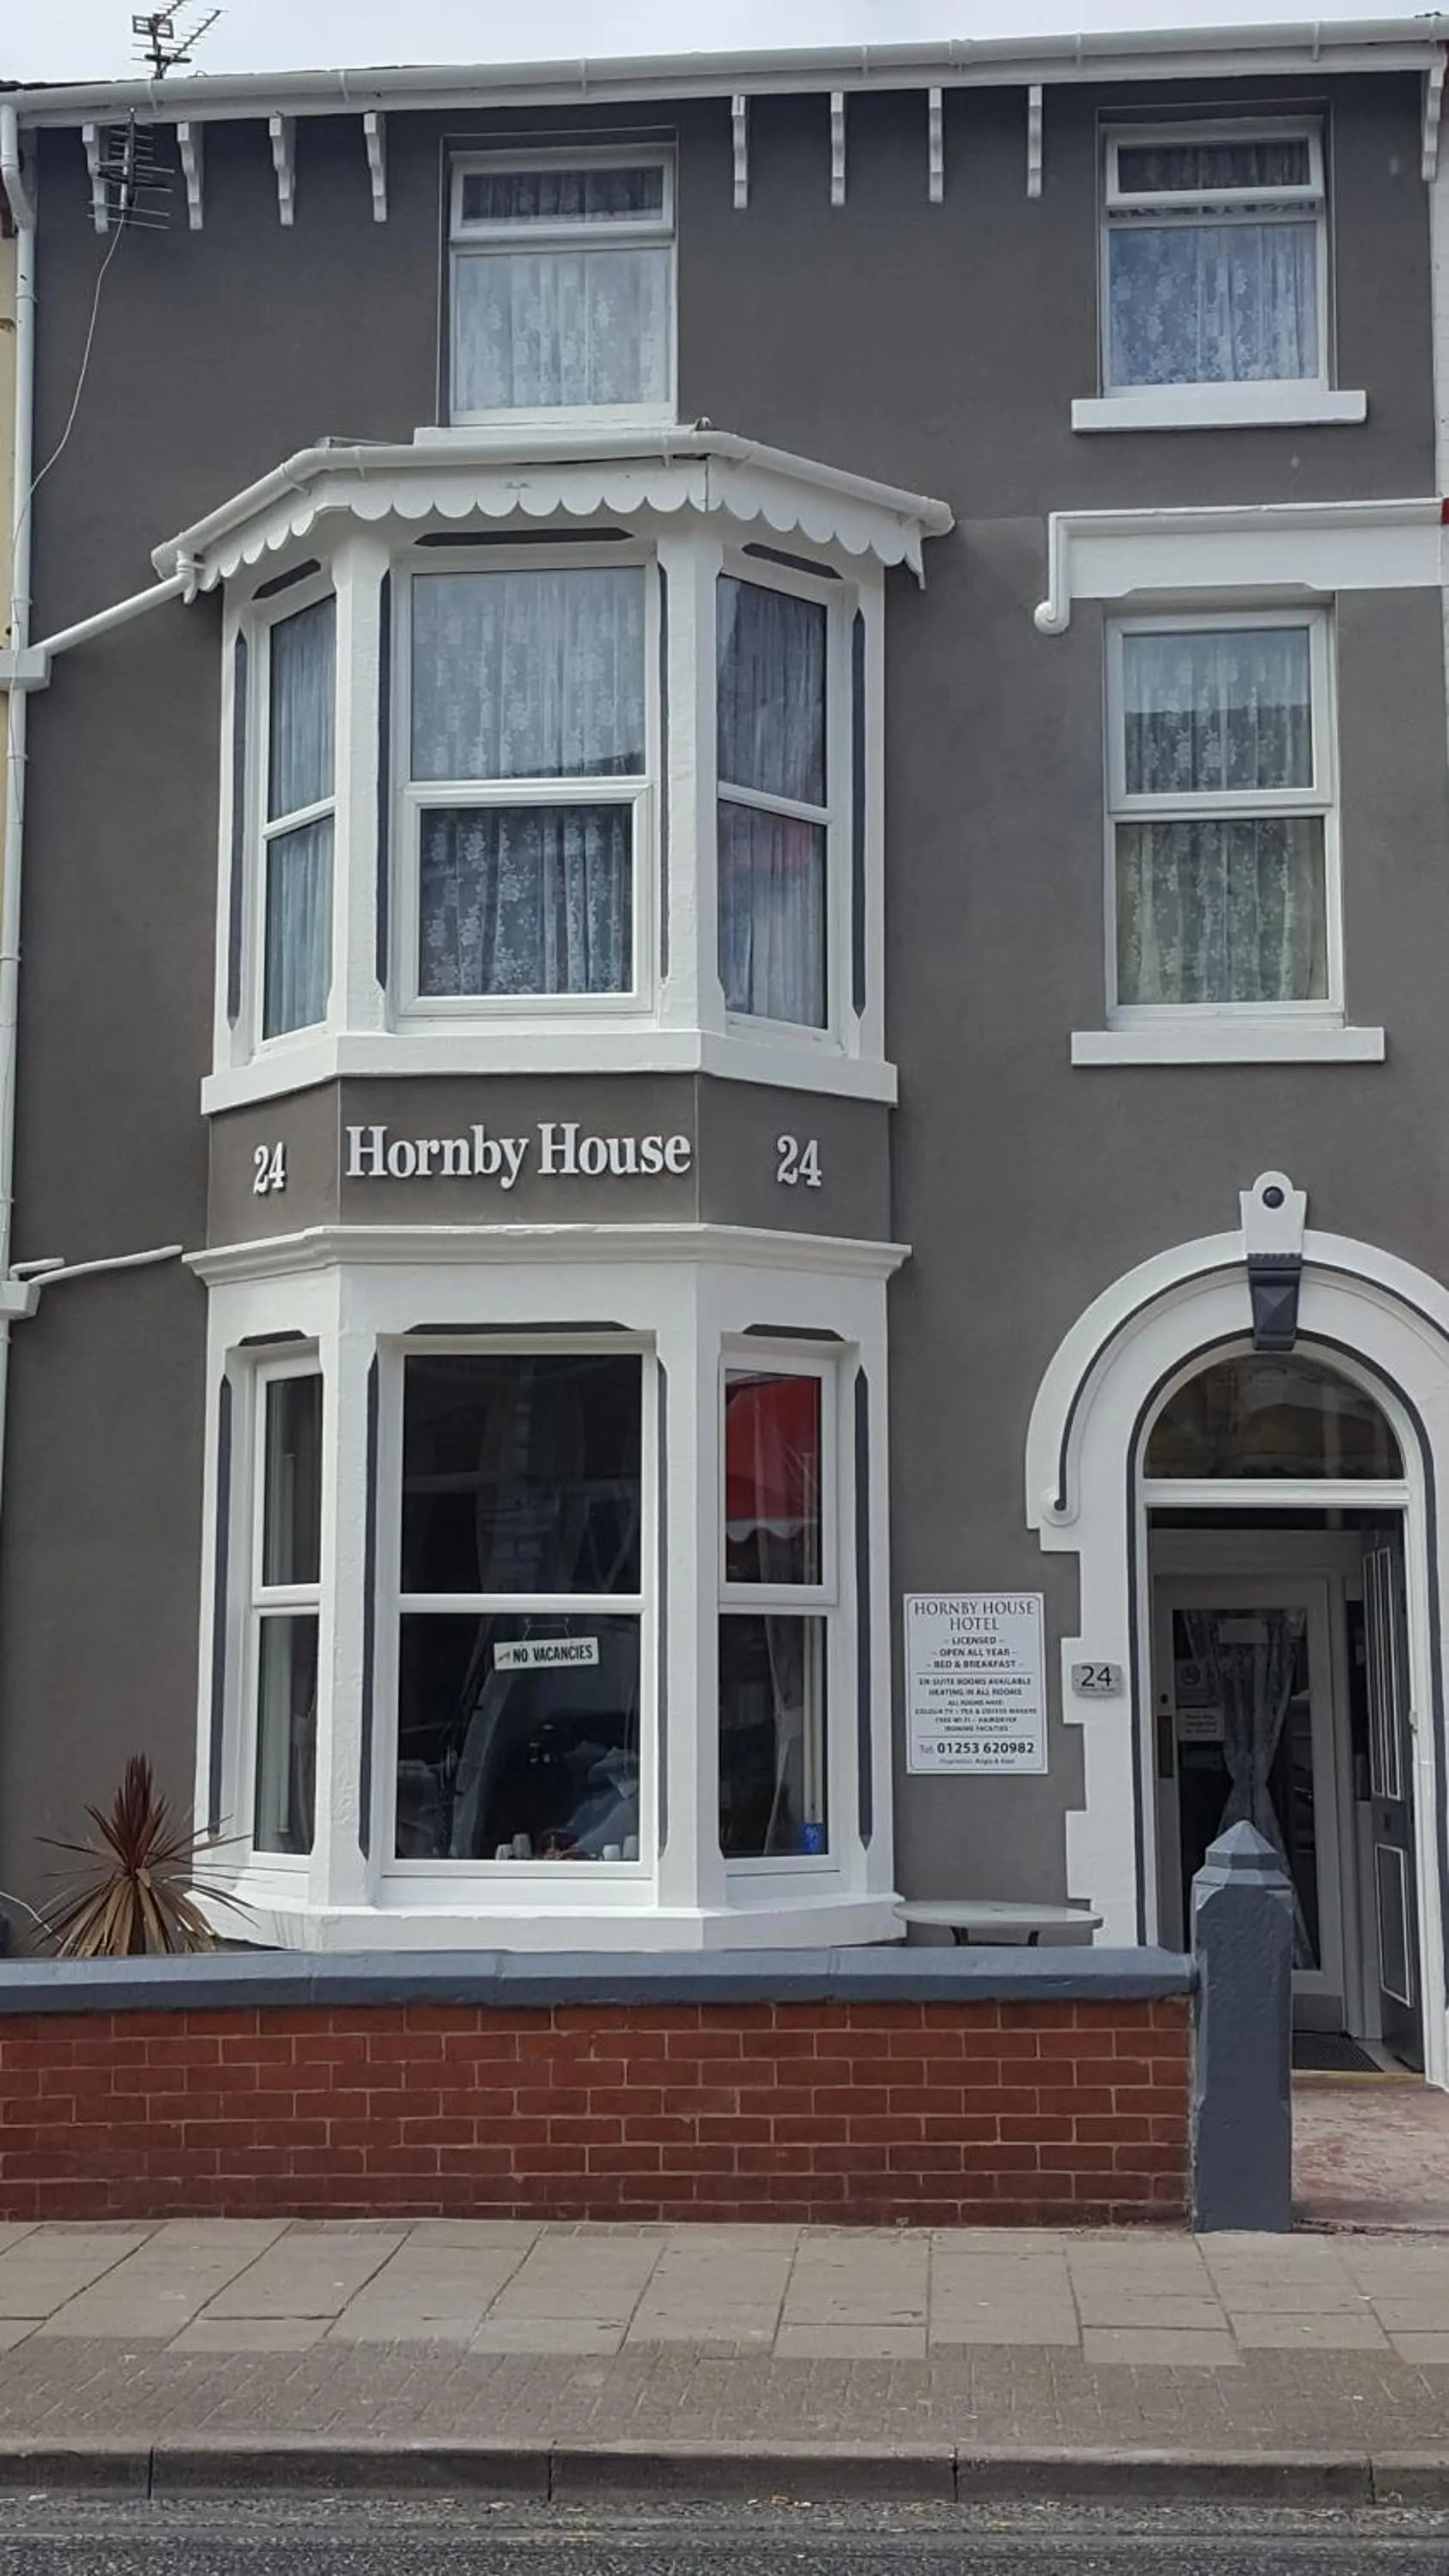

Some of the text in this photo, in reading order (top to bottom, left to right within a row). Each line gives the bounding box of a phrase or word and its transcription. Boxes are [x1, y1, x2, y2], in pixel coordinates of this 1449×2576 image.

[345, 1122, 692, 1190] Hornby House
[777, 1134, 823, 1187] 24
[253, 1141, 288, 1194] 24
[914, 1601, 1035, 1615] HORNBY HOUSE
[949, 1618, 999, 1631] HOTEL
[952, 1636, 997, 1644] LICENSED
[512, 1648, 529, 1663] NO
[531, 1643, 594, 1663] VACANCIES
[939, 1648, 1010, 1656] OPEN ALL YEAR
[933, 1659, 1017, 1668] BED & BREAKFAST
[988, 1677, 1031, 1686] AVAILABLE
[1081, 1666, 1113, 1687] 24
[937, 1742, 979, 1754] 01253
[983, 1741, 1035, 1754] 620982
